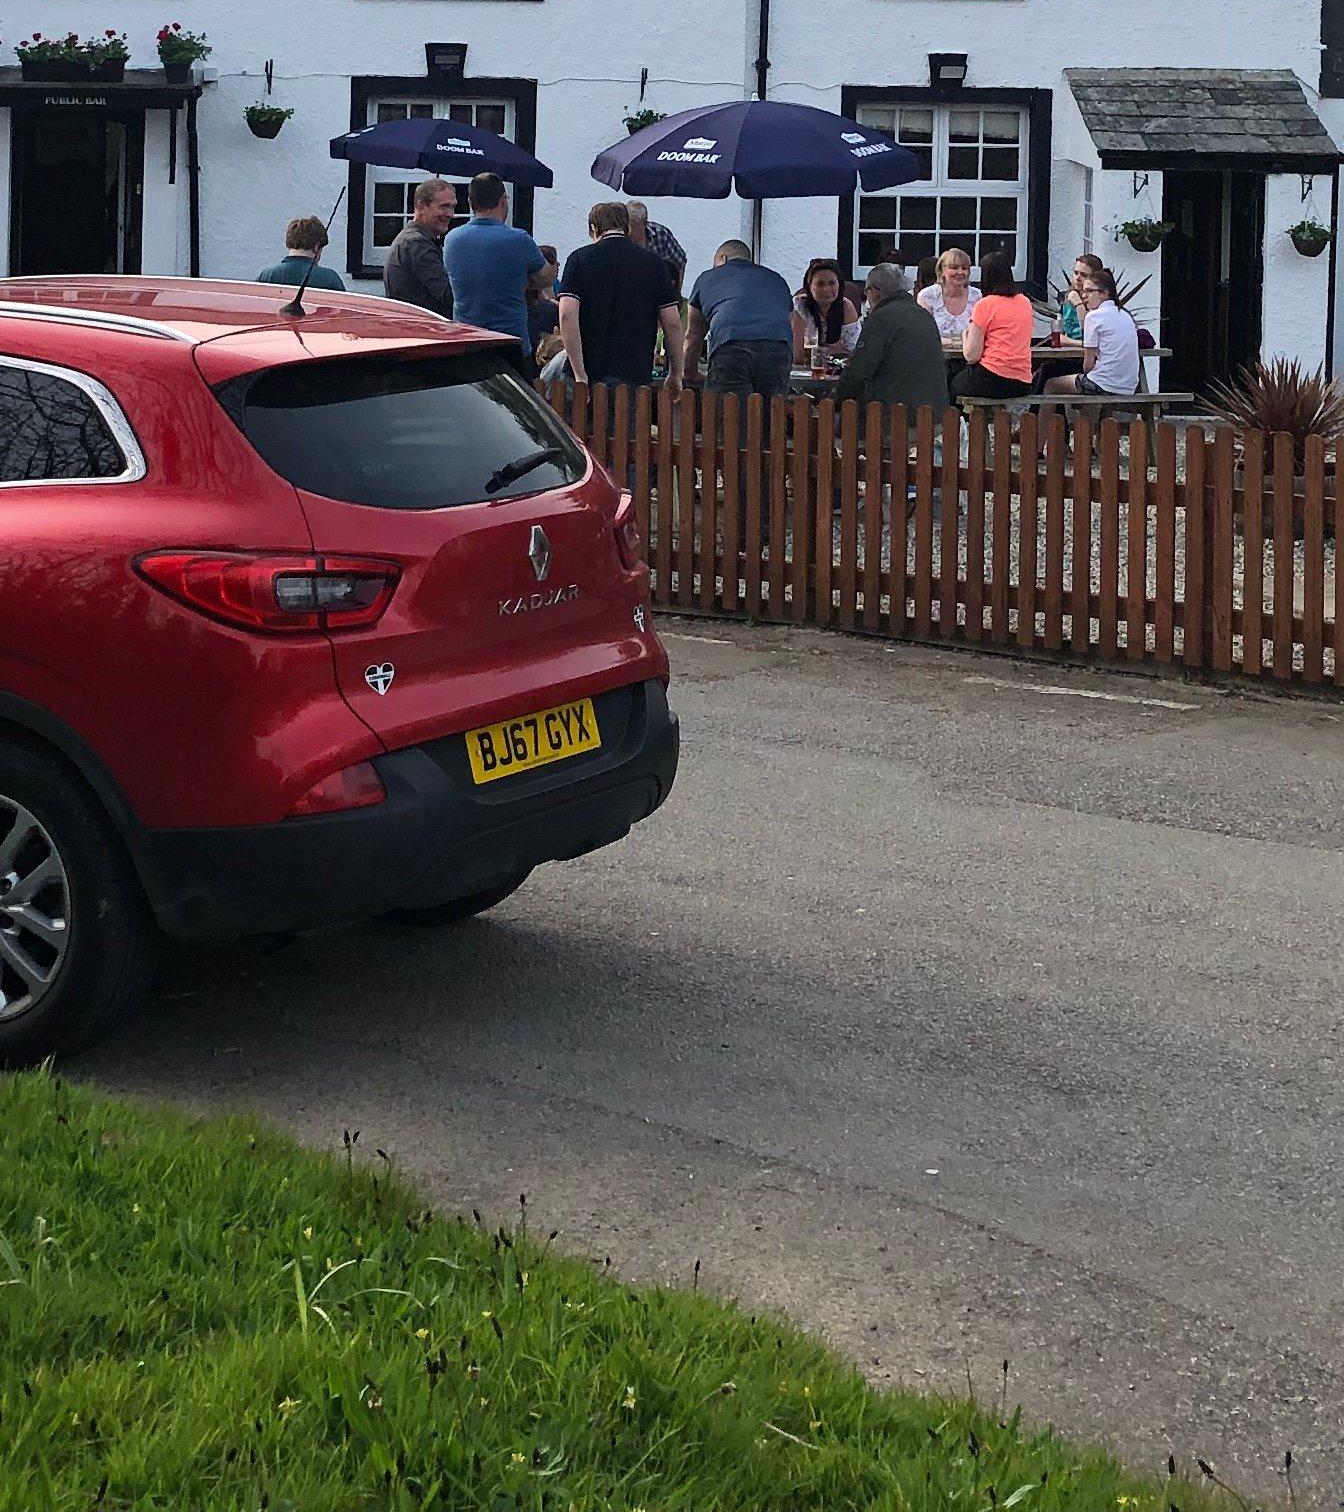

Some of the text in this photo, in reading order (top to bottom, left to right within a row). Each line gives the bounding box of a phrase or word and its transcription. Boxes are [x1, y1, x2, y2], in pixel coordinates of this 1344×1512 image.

[656, 150, 719, 164] DOOM BAR
[497, 584, 579, 616] KADJAR
[477, 705, 591, 772] BJ67 GYX
